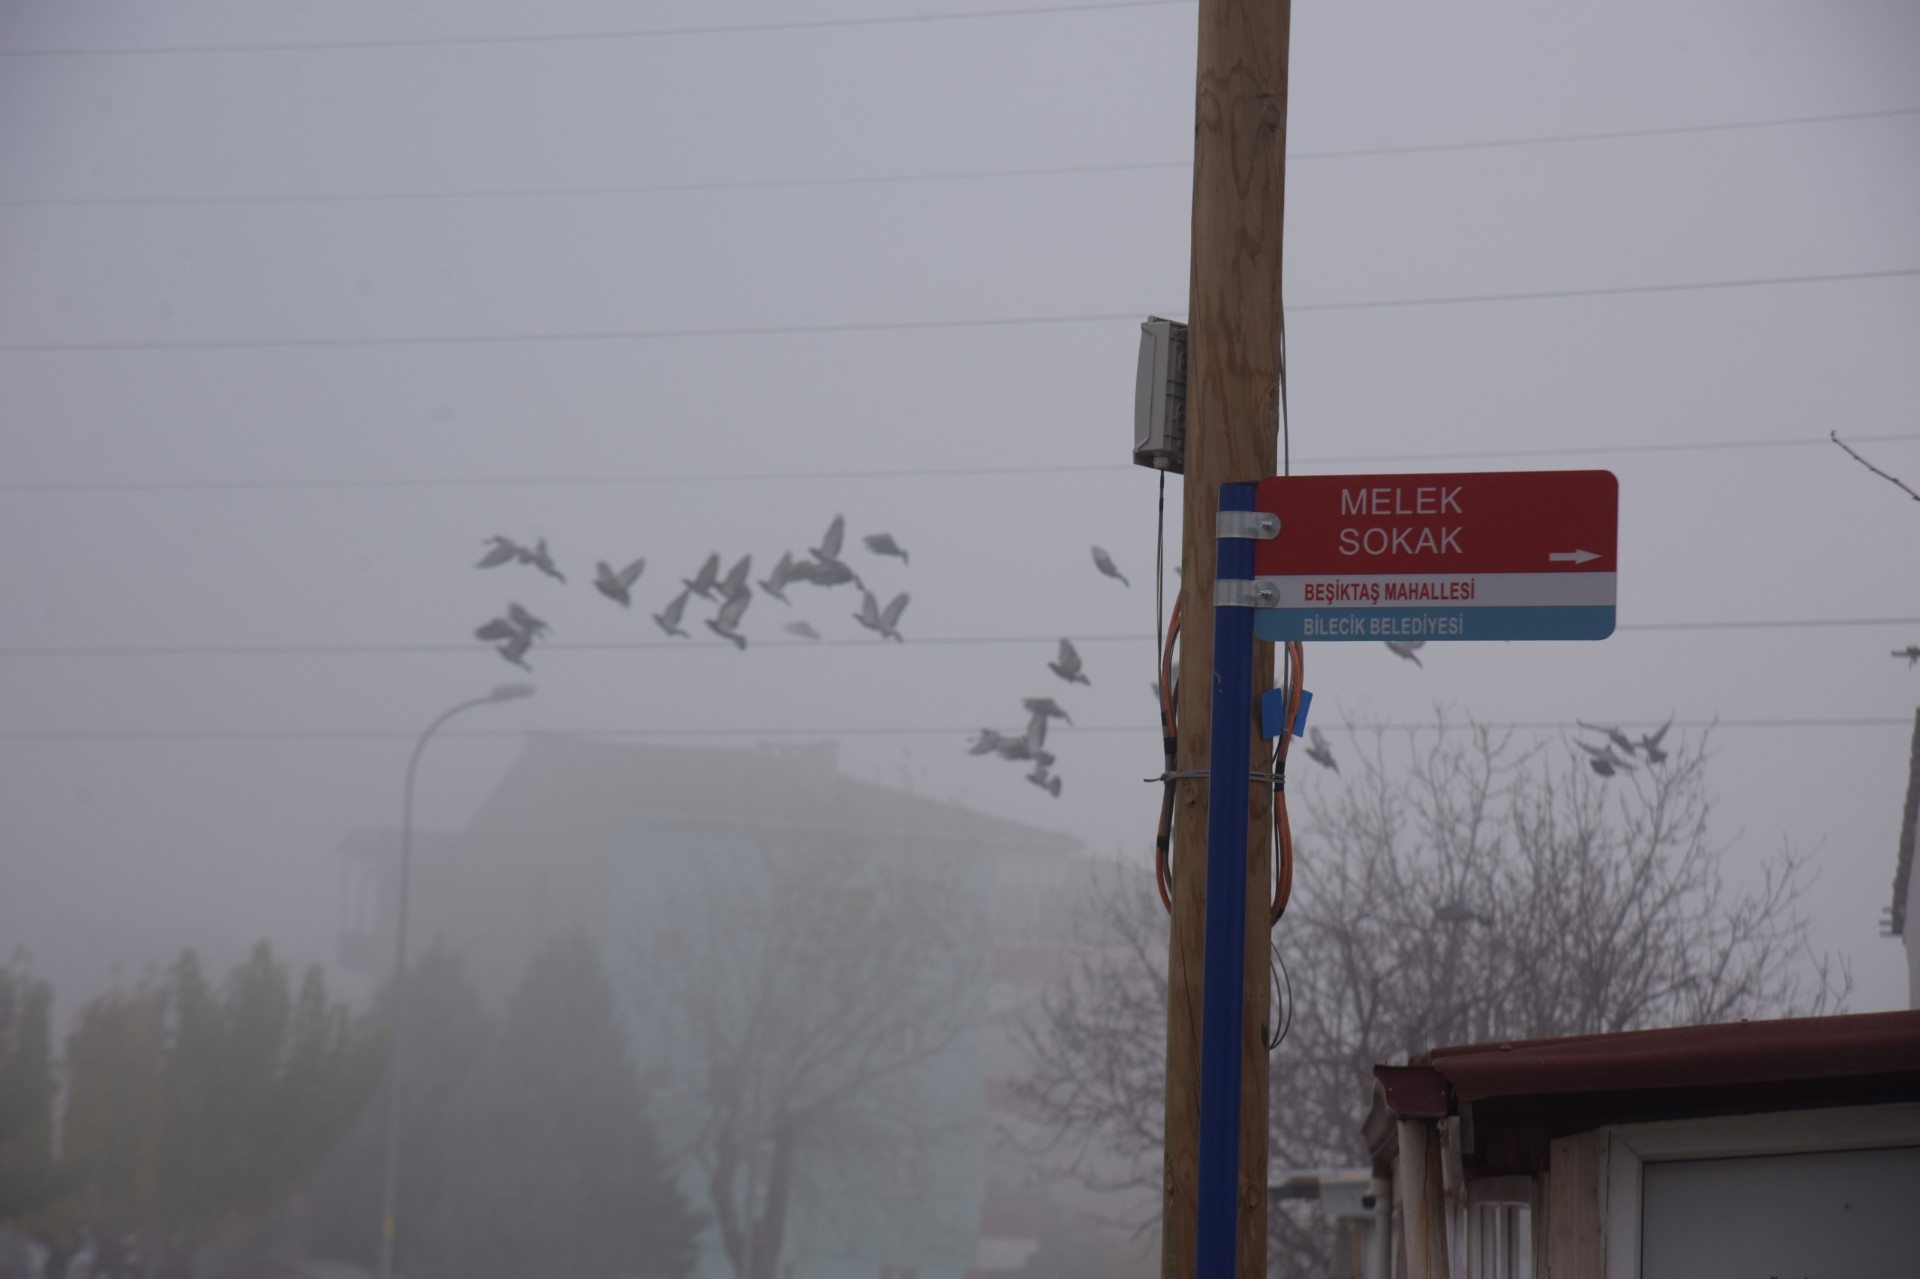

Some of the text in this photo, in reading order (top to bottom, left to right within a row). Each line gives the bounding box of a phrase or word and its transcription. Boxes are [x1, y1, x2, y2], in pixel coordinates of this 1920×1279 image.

[1341, 487, 1463, 515] MELEK
[1338, 527, 1463, 555] SOKAK
[1304, 578, 1475, 605] BEŞİKTAŞ MAHALLESİ
[1304, 613, 1463, 635] BİLECİK BELEDİYESİ
